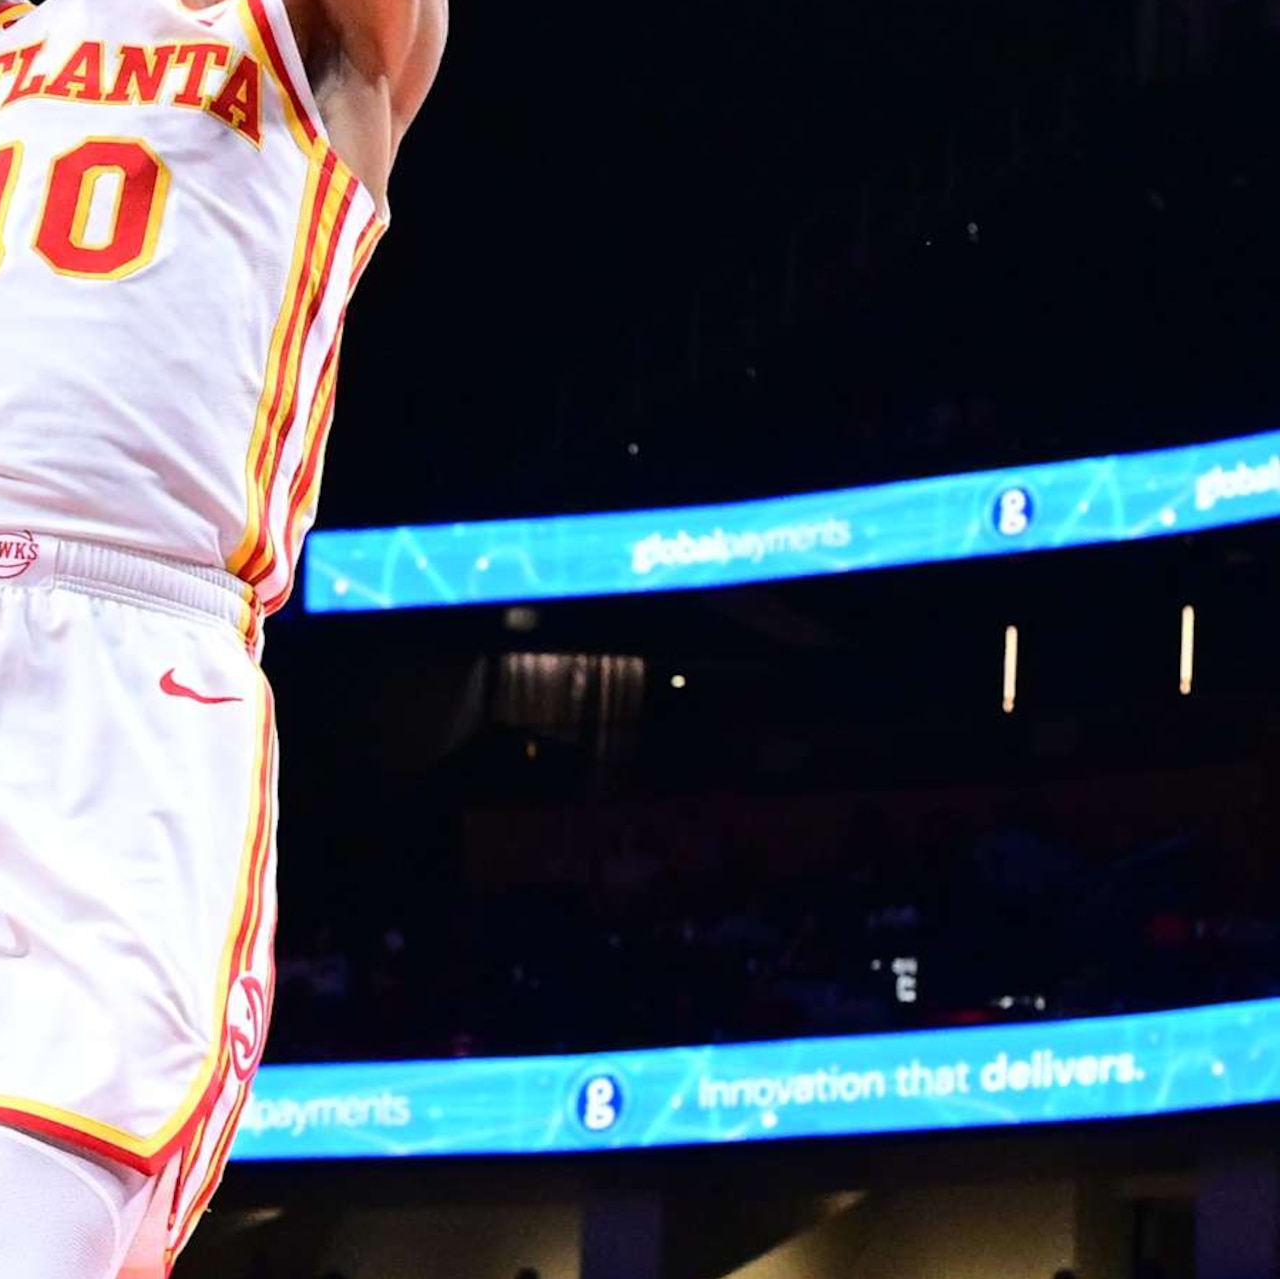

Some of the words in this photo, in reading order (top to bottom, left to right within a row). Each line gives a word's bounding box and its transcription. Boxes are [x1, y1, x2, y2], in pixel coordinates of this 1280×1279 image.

[698, 1062, 886, 1109] Innovation
[896, 1059, 970, 1097] that
[980, 1049, 1146, 1093] delivers.
